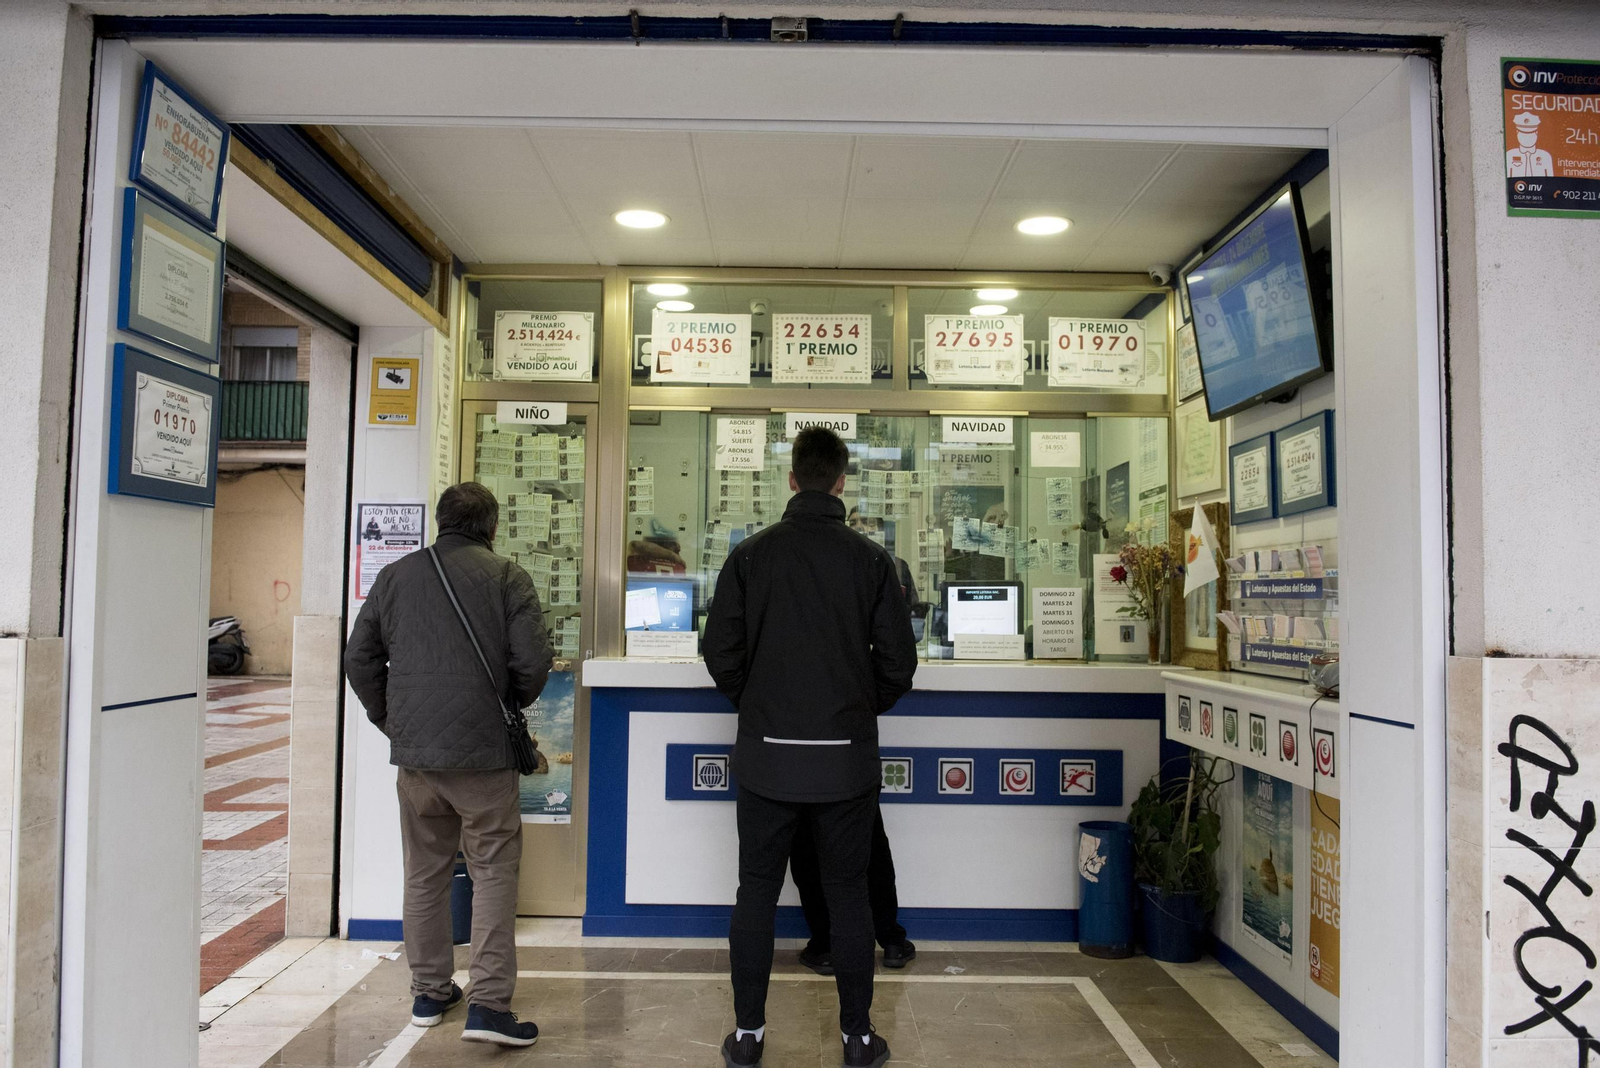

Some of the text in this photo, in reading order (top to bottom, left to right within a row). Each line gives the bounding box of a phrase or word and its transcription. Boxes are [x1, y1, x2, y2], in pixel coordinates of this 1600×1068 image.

[166, 104, 210, 145] ENHORABUENA
[1566, 128, 1598, 144] 24h
[164, 138, 190, 163] VENDIDO
[172, 122, 215, 171] 84442
[1558, 158, 1600, 168] intervenci
[1563, 167, 1600, 177] inmediat
[1562, 190, 1596, 200] 902 211
[681, 322, 736, 334] PREMIO
[784, 323, 860, 338] 22654
[956, 320, 1004, 329] PREMIO
[1080, 322, 1128, 333] PREMIO
[507, 329, 573, 341] 2.514.424
[935, 332, 1013, 347] 27695
[671, 337, 732, 354] 04536
[799, 343, 858, 355] PREMIO
[1058, 335, 1138, 351] 01970
[507, 361, 577, 371] VENDIDO AQUÍ
[166, 390, 189, 404] DIPLOMA
[162, 399, 176, 410] Primer
[515, 406, 550, 420] NIÑO
[154, 409, 196, 434] 01970
[794, 421, 849, 431] NAVIDAD
[951, 422, 1006, 432] NAVIDAD
[156, 431, 179, 444] VENDIDO
[950, 454, 992, 463] PREMIO
[1240, 466, 1260, 480] 22654
[386, 507, 398, 515] TAN
[400, 508, 420, 516] CERCA
[383, 516, 396, 524] QUE
[1252, 583, 1268, 593] Loterías
[1268, 586, 1271, 595] y
[1272, 583, 1291, 594] Apuestas
[1300, 582, 1316, 593] Estado
[1251, 648, 1268, 658] Loterías
[1272, 650, 1292, 661] Apuestas
[1257, 782, 1273, 801] AQUÍ
[1312, 848, 1340, 882] EDAD
